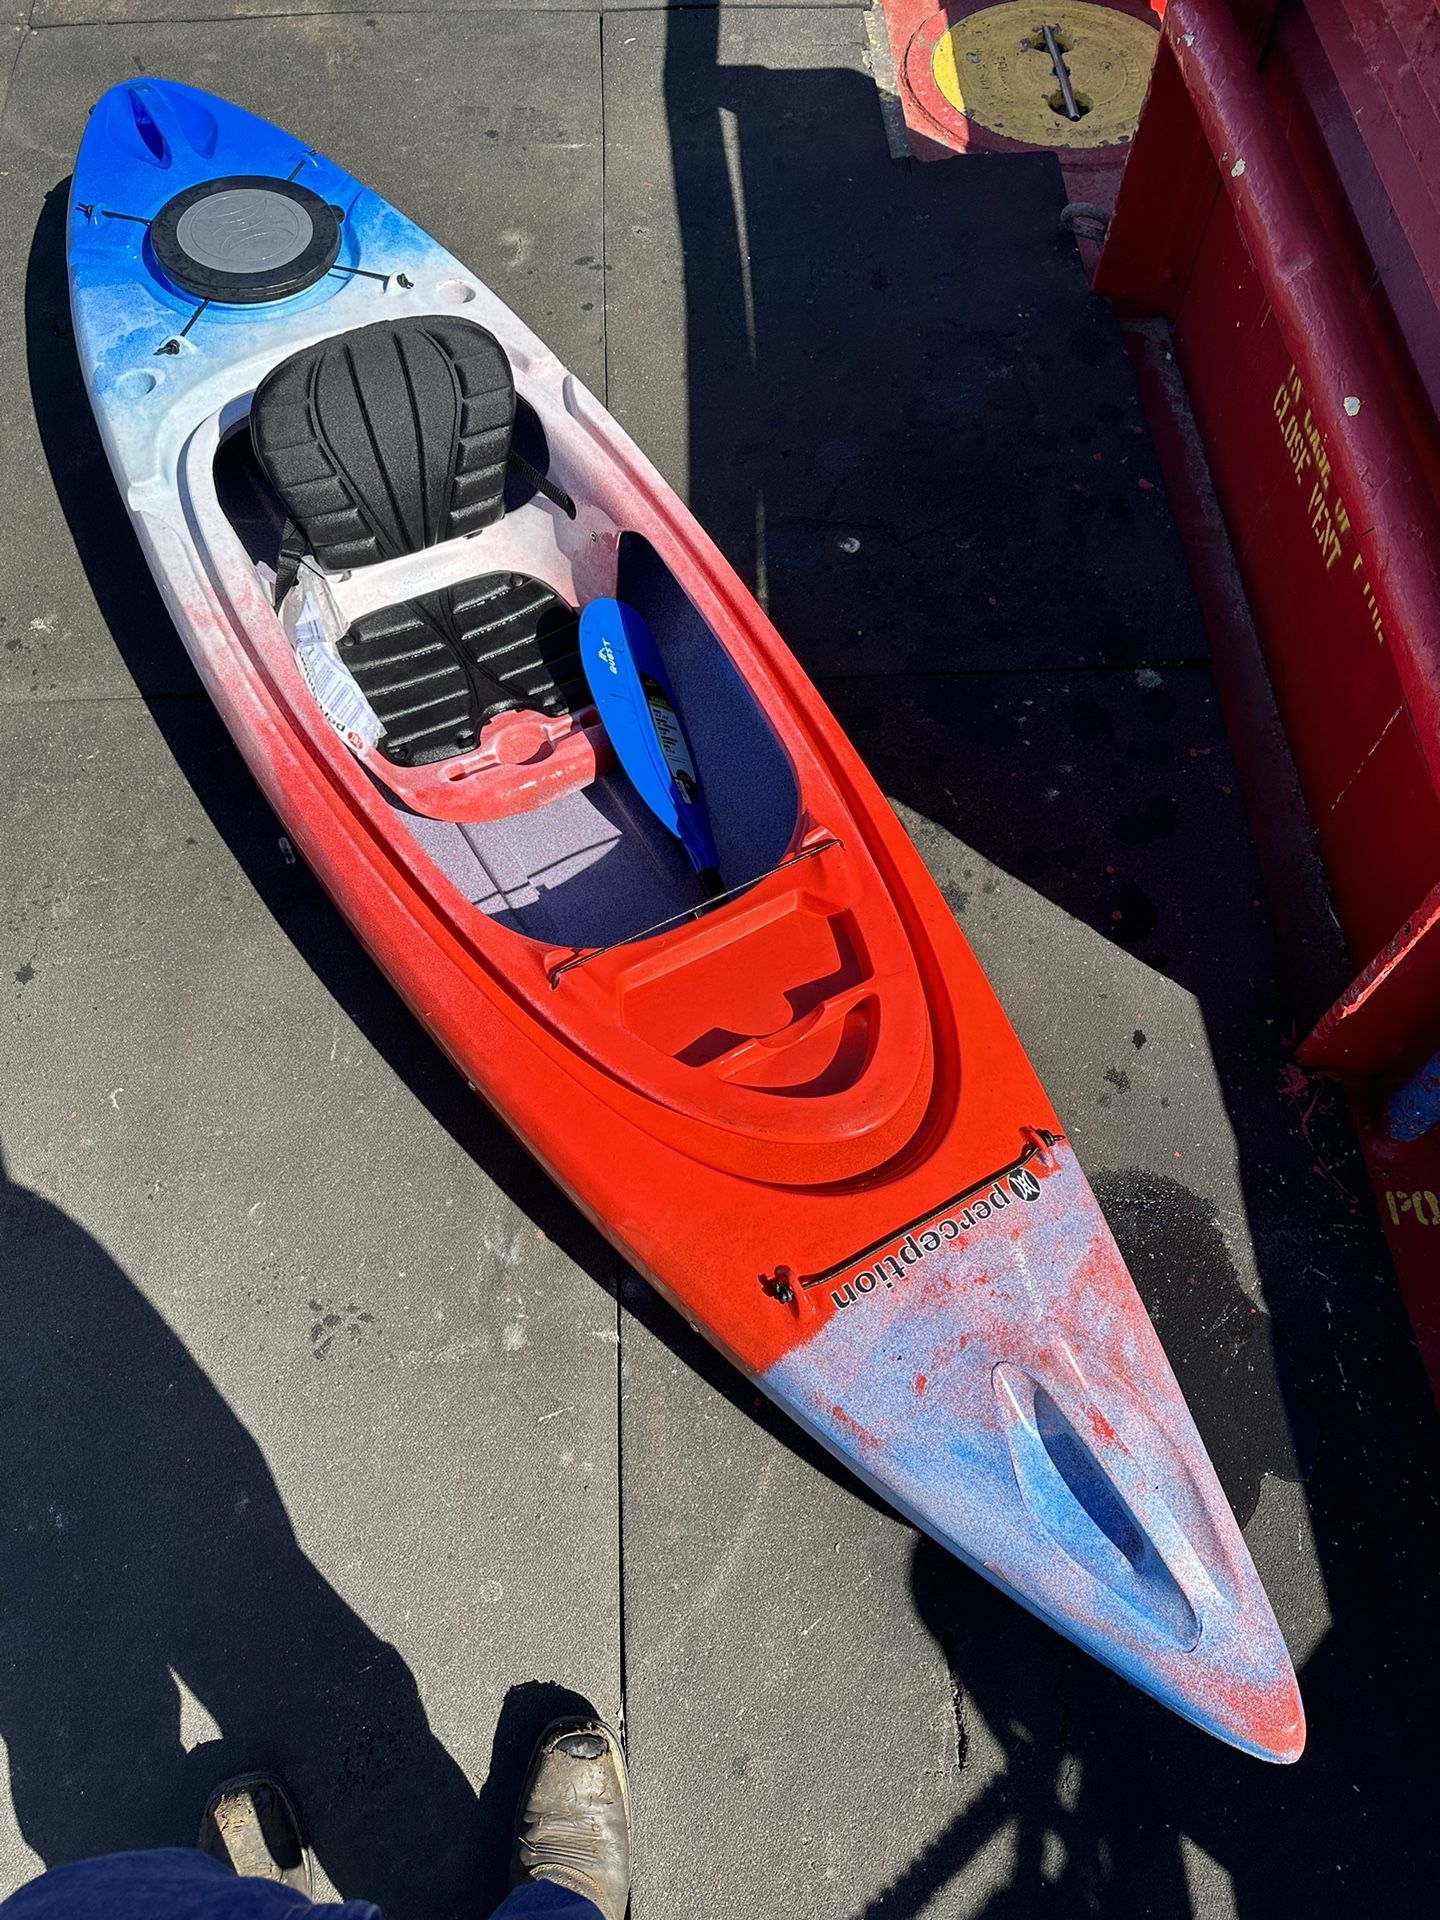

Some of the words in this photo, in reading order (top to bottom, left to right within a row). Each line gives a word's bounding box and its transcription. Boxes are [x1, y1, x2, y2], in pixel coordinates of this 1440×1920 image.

[1273, 384, 1311, 486] CLOSE
[1308, 482, 1342, 568] VENT
[601, 636, 618, 675] QUEST
[831, 1182, 1011, 1309] perception
